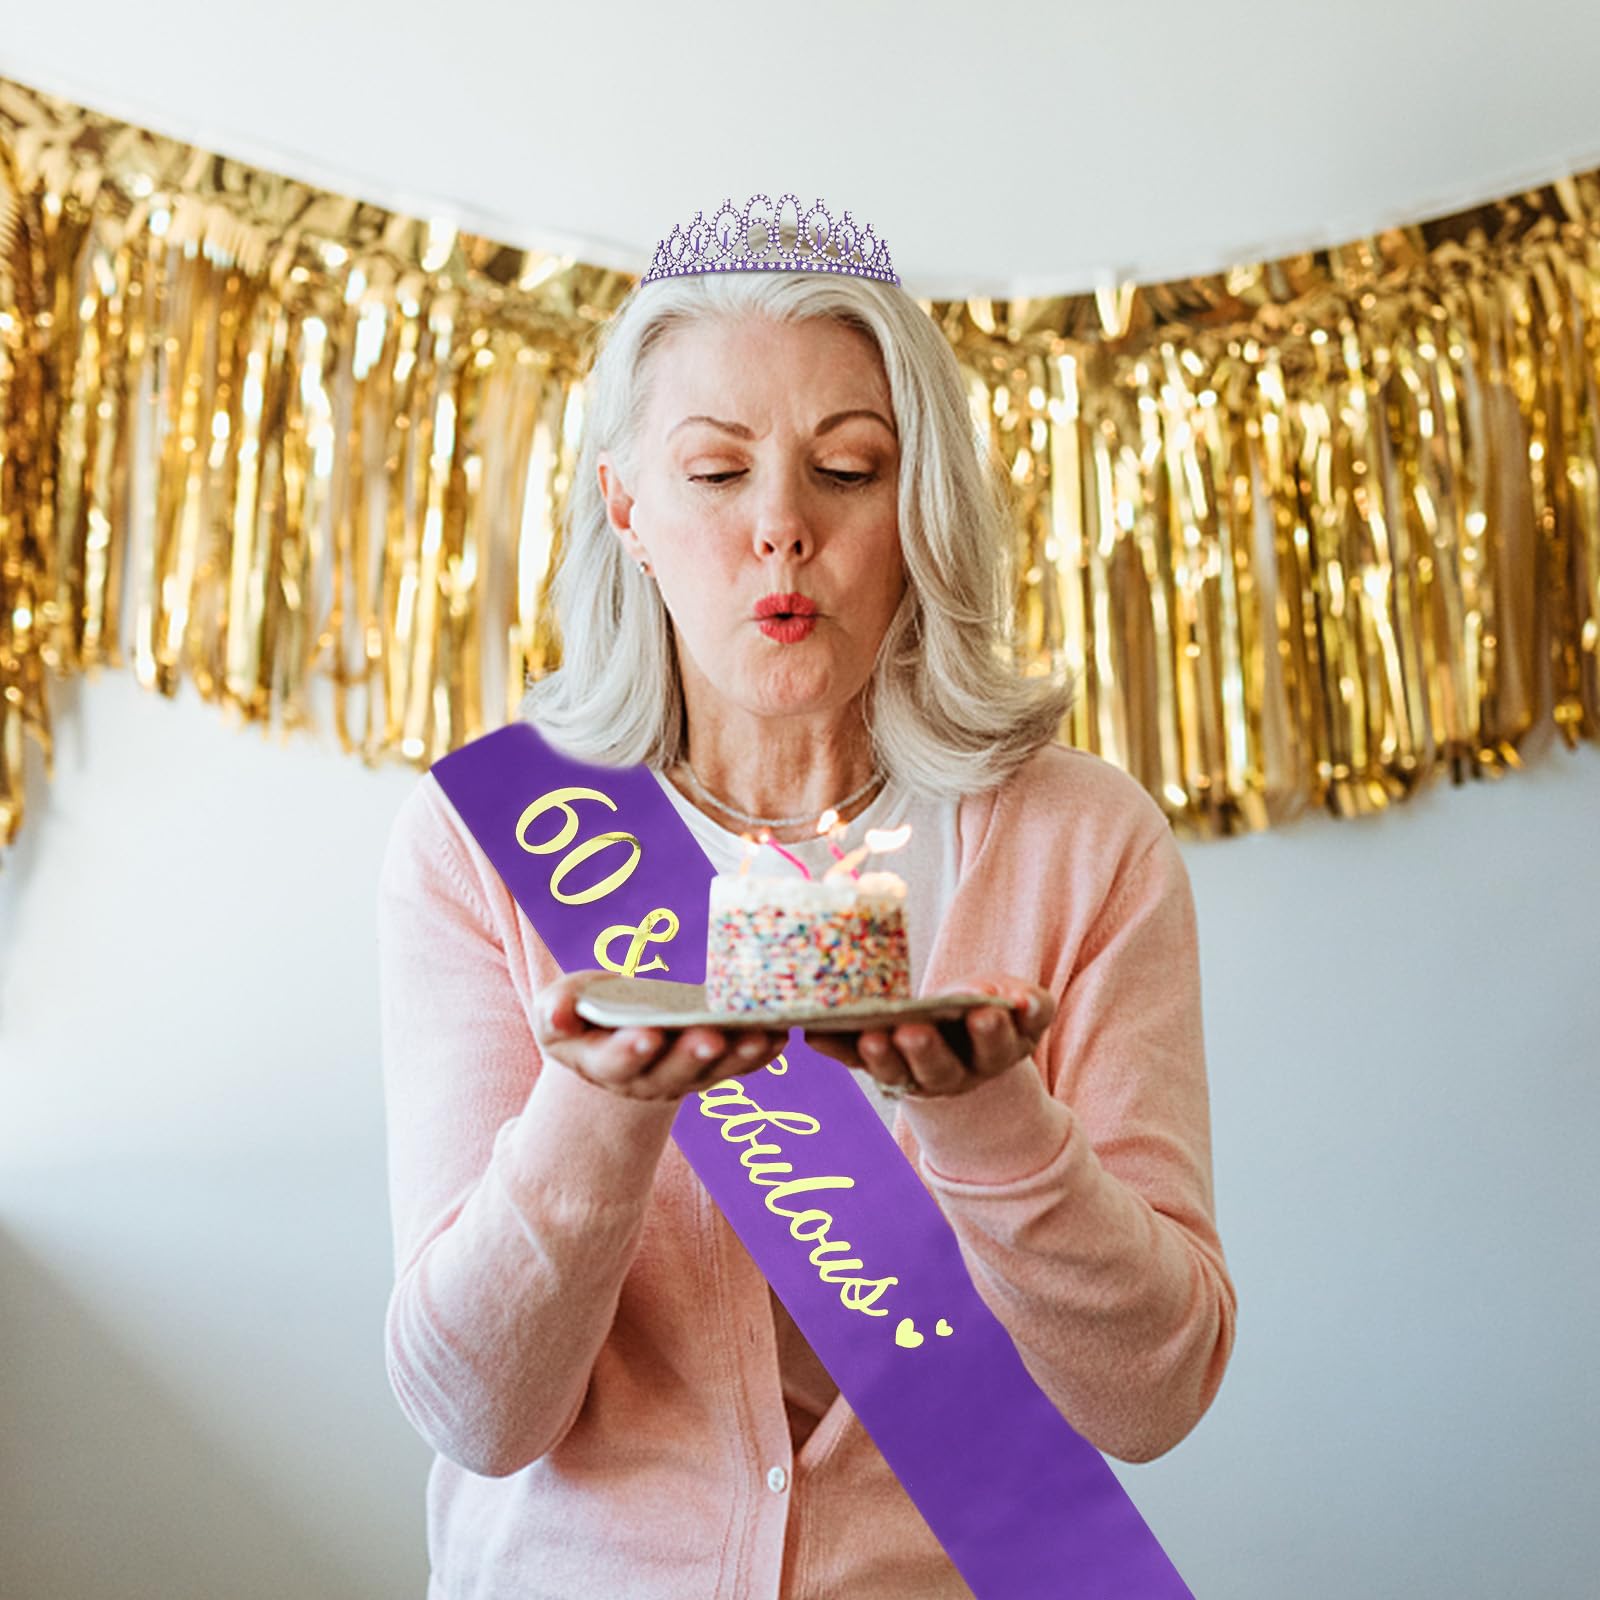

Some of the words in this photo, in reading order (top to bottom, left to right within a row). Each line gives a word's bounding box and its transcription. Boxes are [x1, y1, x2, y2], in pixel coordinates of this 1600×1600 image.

[742, 193, 803, 260] 60
[515, 787, 641, 905] 60
[593, 907, 680, 978] &
